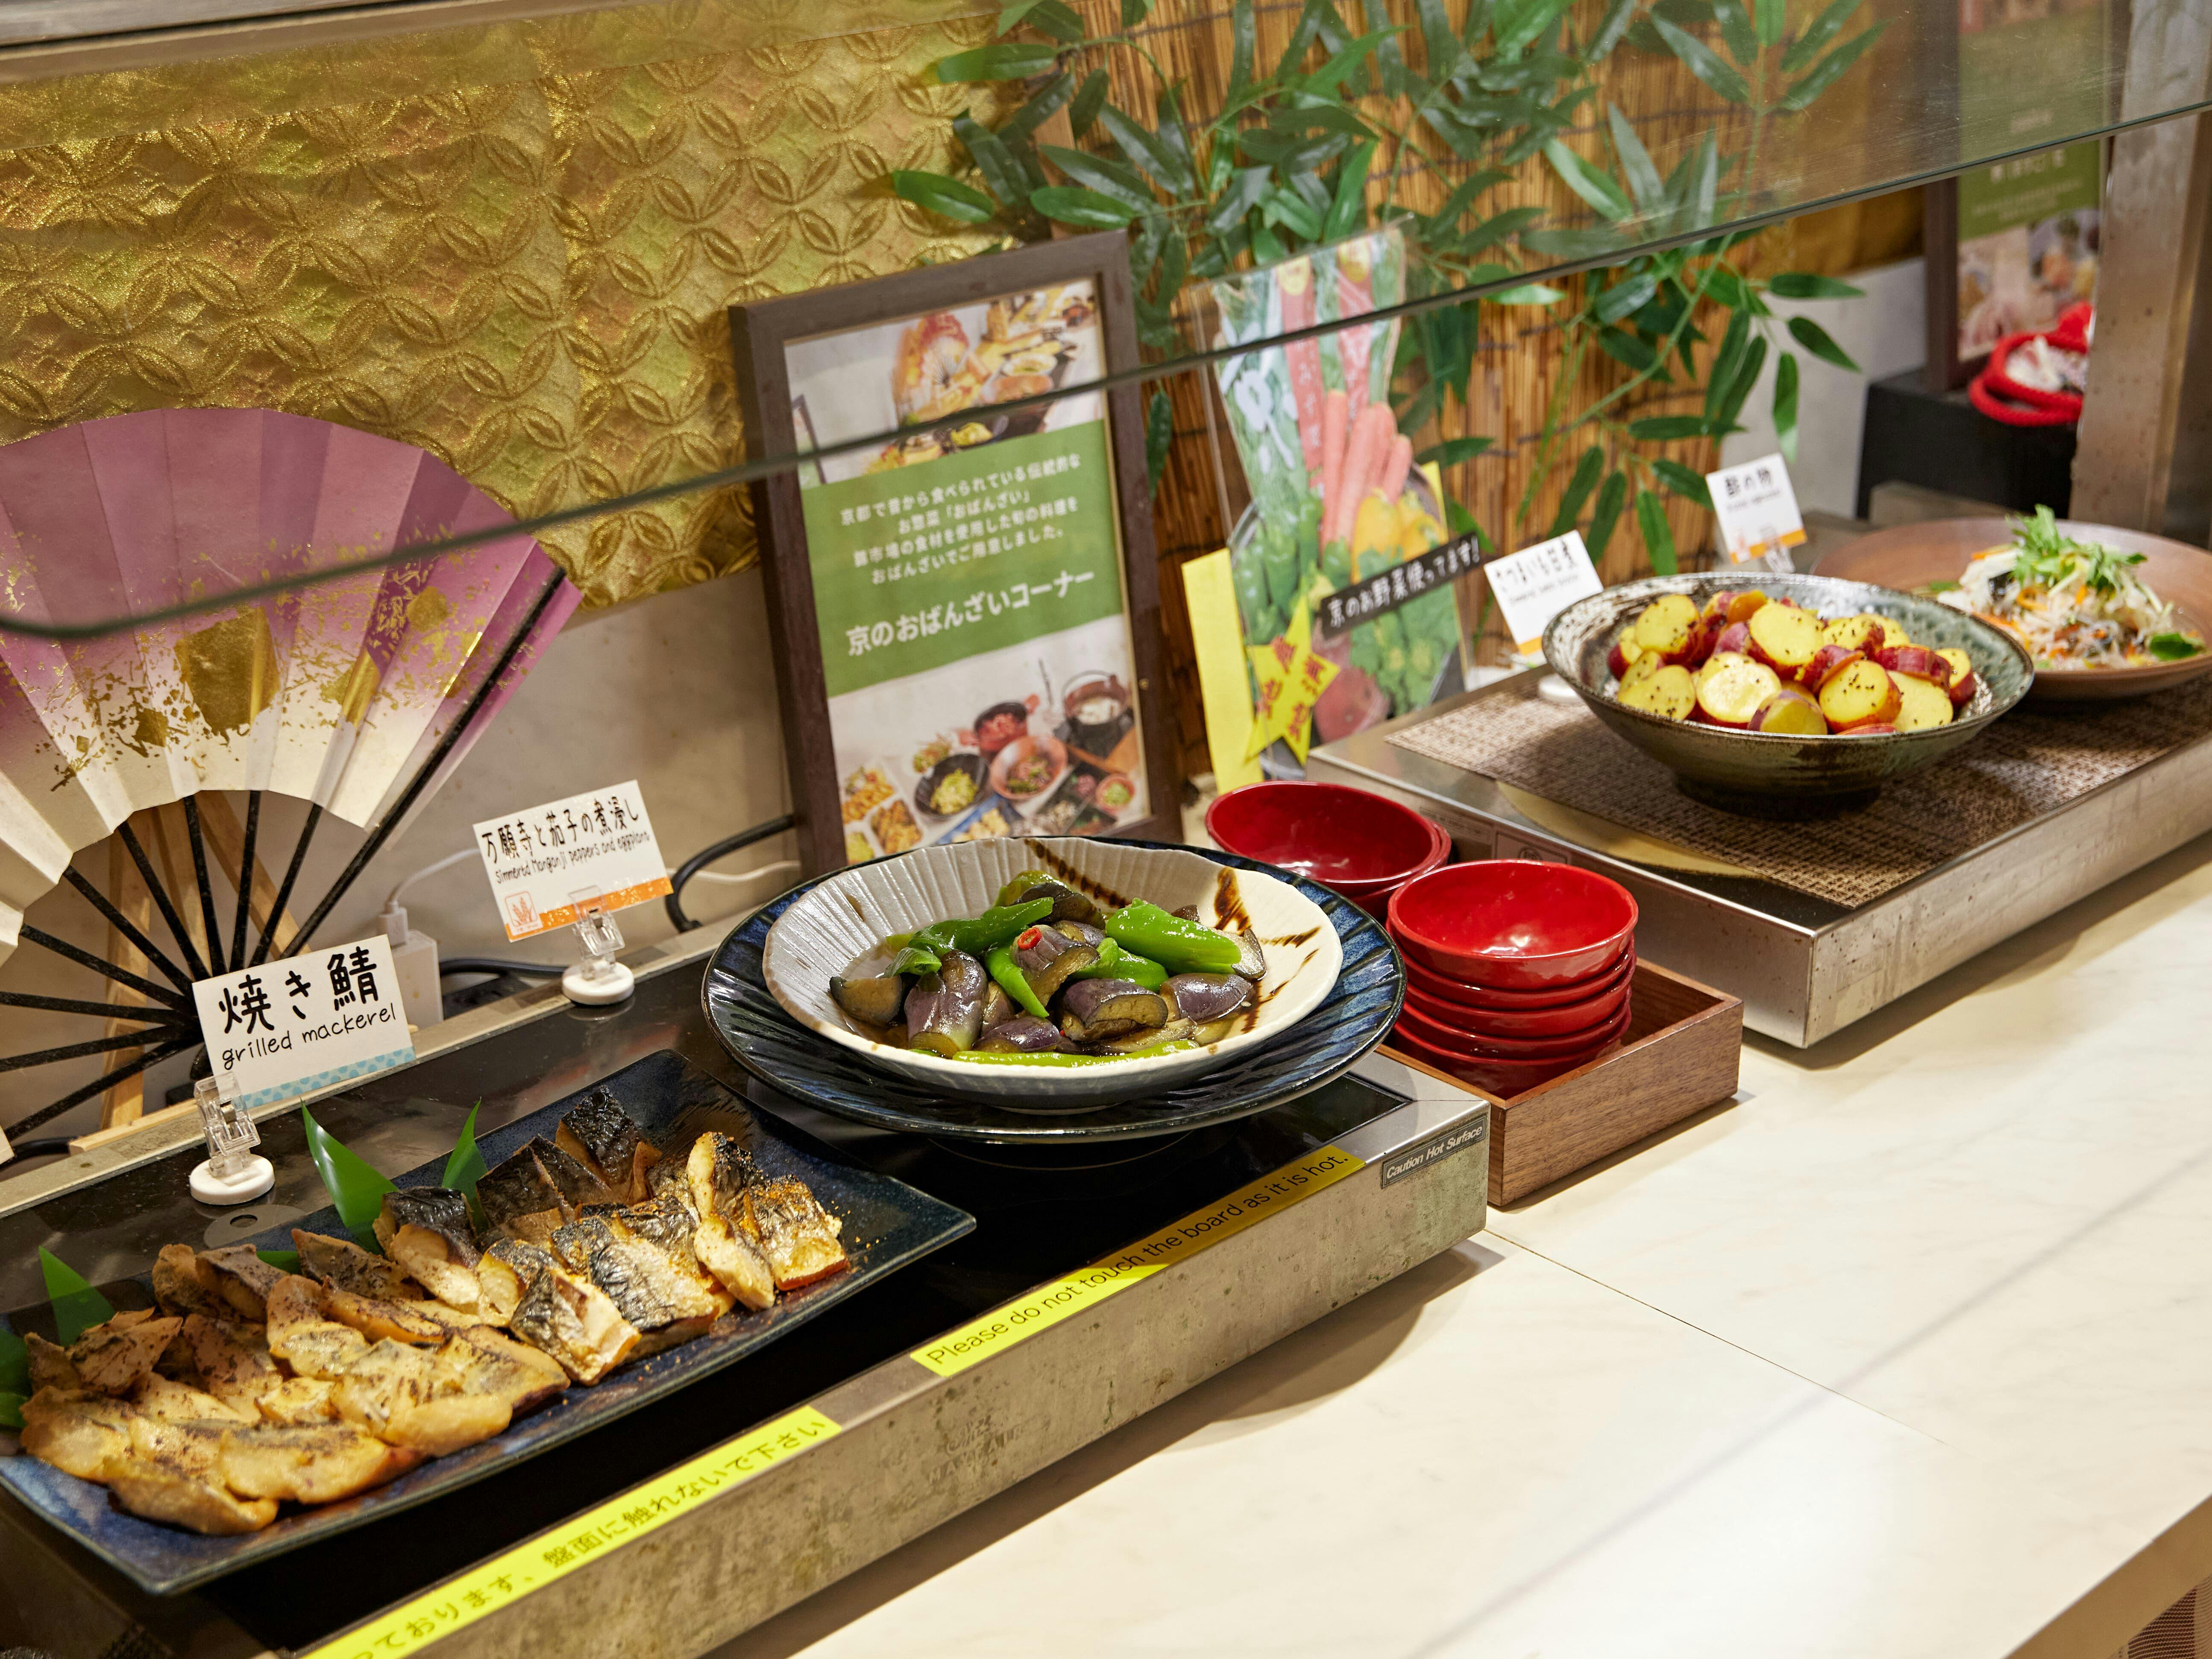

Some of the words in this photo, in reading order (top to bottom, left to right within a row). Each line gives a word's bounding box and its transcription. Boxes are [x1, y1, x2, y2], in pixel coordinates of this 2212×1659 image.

[845, 570, 1094, 656] 京のおばんざいコーナー
[481, 796, 639, 864] 万願寺と茄子の煮浸し
[531, 851, 568, 873] Manganji
[568, 843, 599, 866] peppers
[601, 839, 616, 853] and
[617, 830, 650, 852] eggplant
[219, 946, 377, 1034] 焼き鯖
[222, 1030, 292, 1070] grilled
[302, 1002, 396, 1043] mackerel
[1386, 1154, 1423, 1179] Caution
[1426, 1143, 1445, 1161] Hot
[1446, 1126, 1482, 1150] Surface
[926, 1323, 1009, 1364] Please
[1010, 1307, 1040, 1325] do
[1041, 1286, 1083, 1309] not
[1079, 1255, 1146, 1288] touch
[1143, 1237, 1183, 1257] the
[1177, 1203, 1244, 1239] board
[1243, 1192, 1271, 1208] as
[1264, 1182, 1290, 1196] it
[1282, 1172, 1309, 1186] is
[1301, 1154, 1349, 1177] hot.
